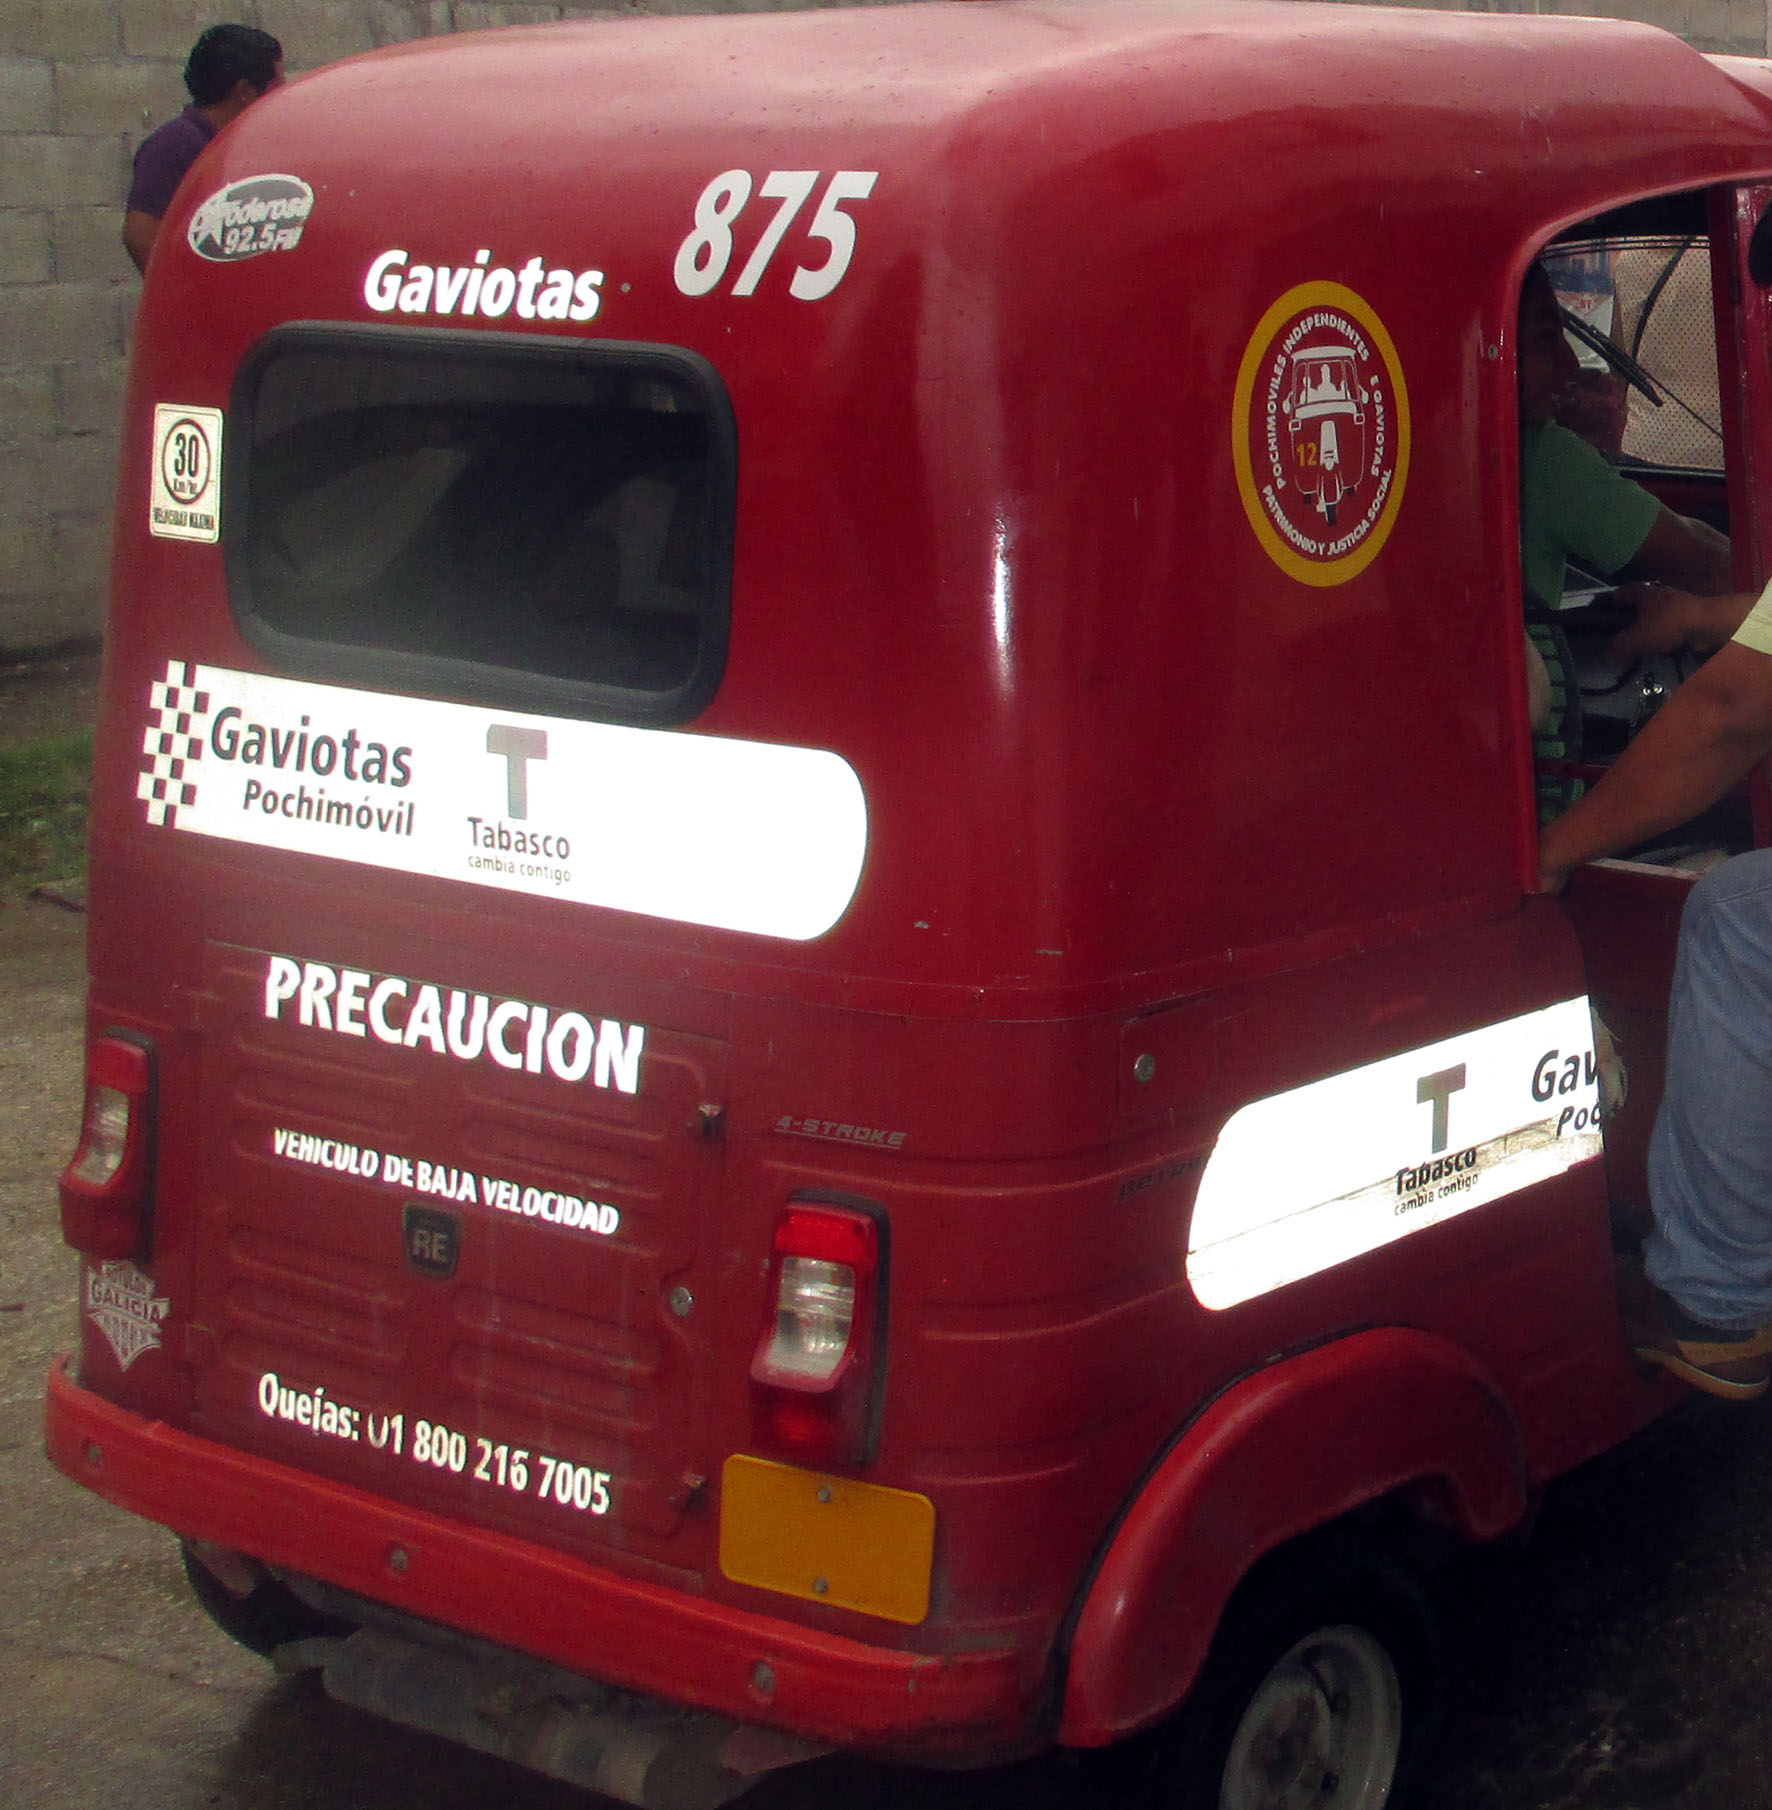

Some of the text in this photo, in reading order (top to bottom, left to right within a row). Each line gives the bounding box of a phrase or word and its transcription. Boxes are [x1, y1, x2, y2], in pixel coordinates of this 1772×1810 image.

[674, 168, 880, 301] 875
[364, 249, 603, 322] Gaviotas
[1267, 354, 1287, 490] POCHIMOVILES
[1282, 312, 1371, 362] INDEPENDIENTES
[174, 432, 199, 478] 30
[1297, 442, 1318, 467] 12
[1262, 484, 1317, 554] PATRIMONIO
[1327, 518, 1371, 556] JUSTICIA
[1368, 468, 1392, 521] SOCIAL
[210, 705, 413, 788] Gaviotas
[242, 778, 415, 837] Pochimóvil
[467, 816, 570, 860] Tabasco
[468, 854, 571, 886] cambia contigo
[263, 955, 647, 1095] PRECAUCION
[776, 1114, 907, 1146] 4-STROKE
[273, 1127, 621, 1236] VEHICULO DE BAJA VELOCIDAD
[1394, 1173, 1479, 1217] cambia contigo
[1396, 1147, 1477, 1196] Tabasco
[412, 1228, 449, 1263] RE
[91, 1277, 164, 1321] GALICIA
[367, 1412, 405, 1455] 01
[413, 1418, 467, 1473] 800
[473, 1437, 531, 1492] 216
[537, 1455, 613, 1516] 7005
